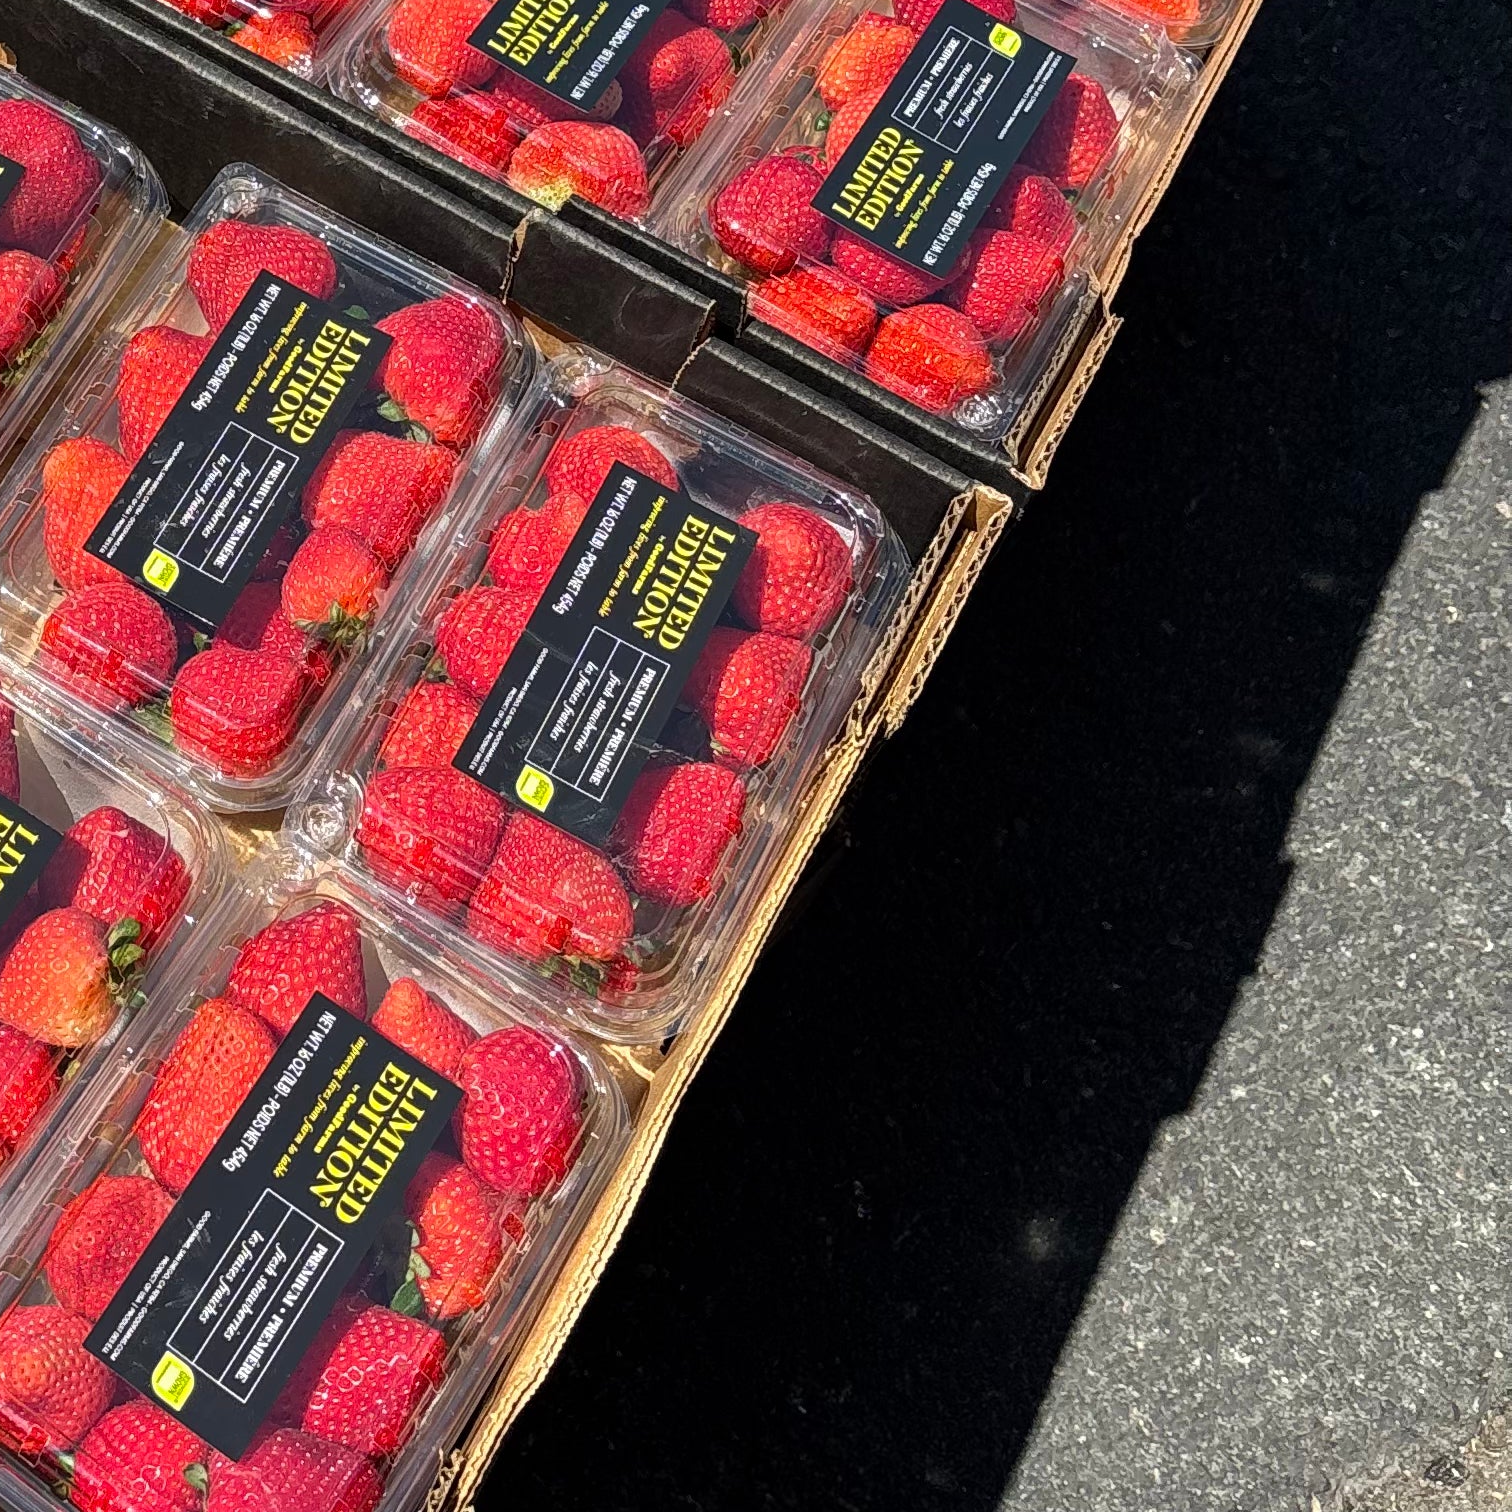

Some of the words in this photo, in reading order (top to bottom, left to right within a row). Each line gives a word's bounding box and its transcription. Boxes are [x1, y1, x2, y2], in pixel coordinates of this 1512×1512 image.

[832, 128, 901, 220] LIMITED
[290, 329, 370, 443] LIMITED
[658, 524, 735, 649] LIMITED
[315, 1010, 336, 1034] NET
[297, 1047, 313, 1061] 16
[303, 1029, 325, 1051] WT.
[287, 1057, 306, 1077] OZ
[332, 1036, 367, 1080] improving
[273, 1069, 297, 1097] (1LB)
[320, 1078, 341, 1100] lives
[251, 1096, 280, 1131] POIDS
[305, 1094, 327, 1121] from
[293, 1116, 313, 1144] farm
[313, 1093, 357, 1153] GoodFarms
[240, 1126, 261, 1151] NET
[287, 1143, 298, 1154] to
[335, 1076, 437, 1223] LIMITED
[221, 1145, 248, 1171] 454g
[273, 1153, 291, 1178] table
[248, 1229, 264, 1247] les
[225, 1239, 255, 1282] fraises
[264, 1242, 287, 1277] fresh
[282, 1242, 328, 1307] PREMIUM
[223, 1274, 267, 1341] strawberries
